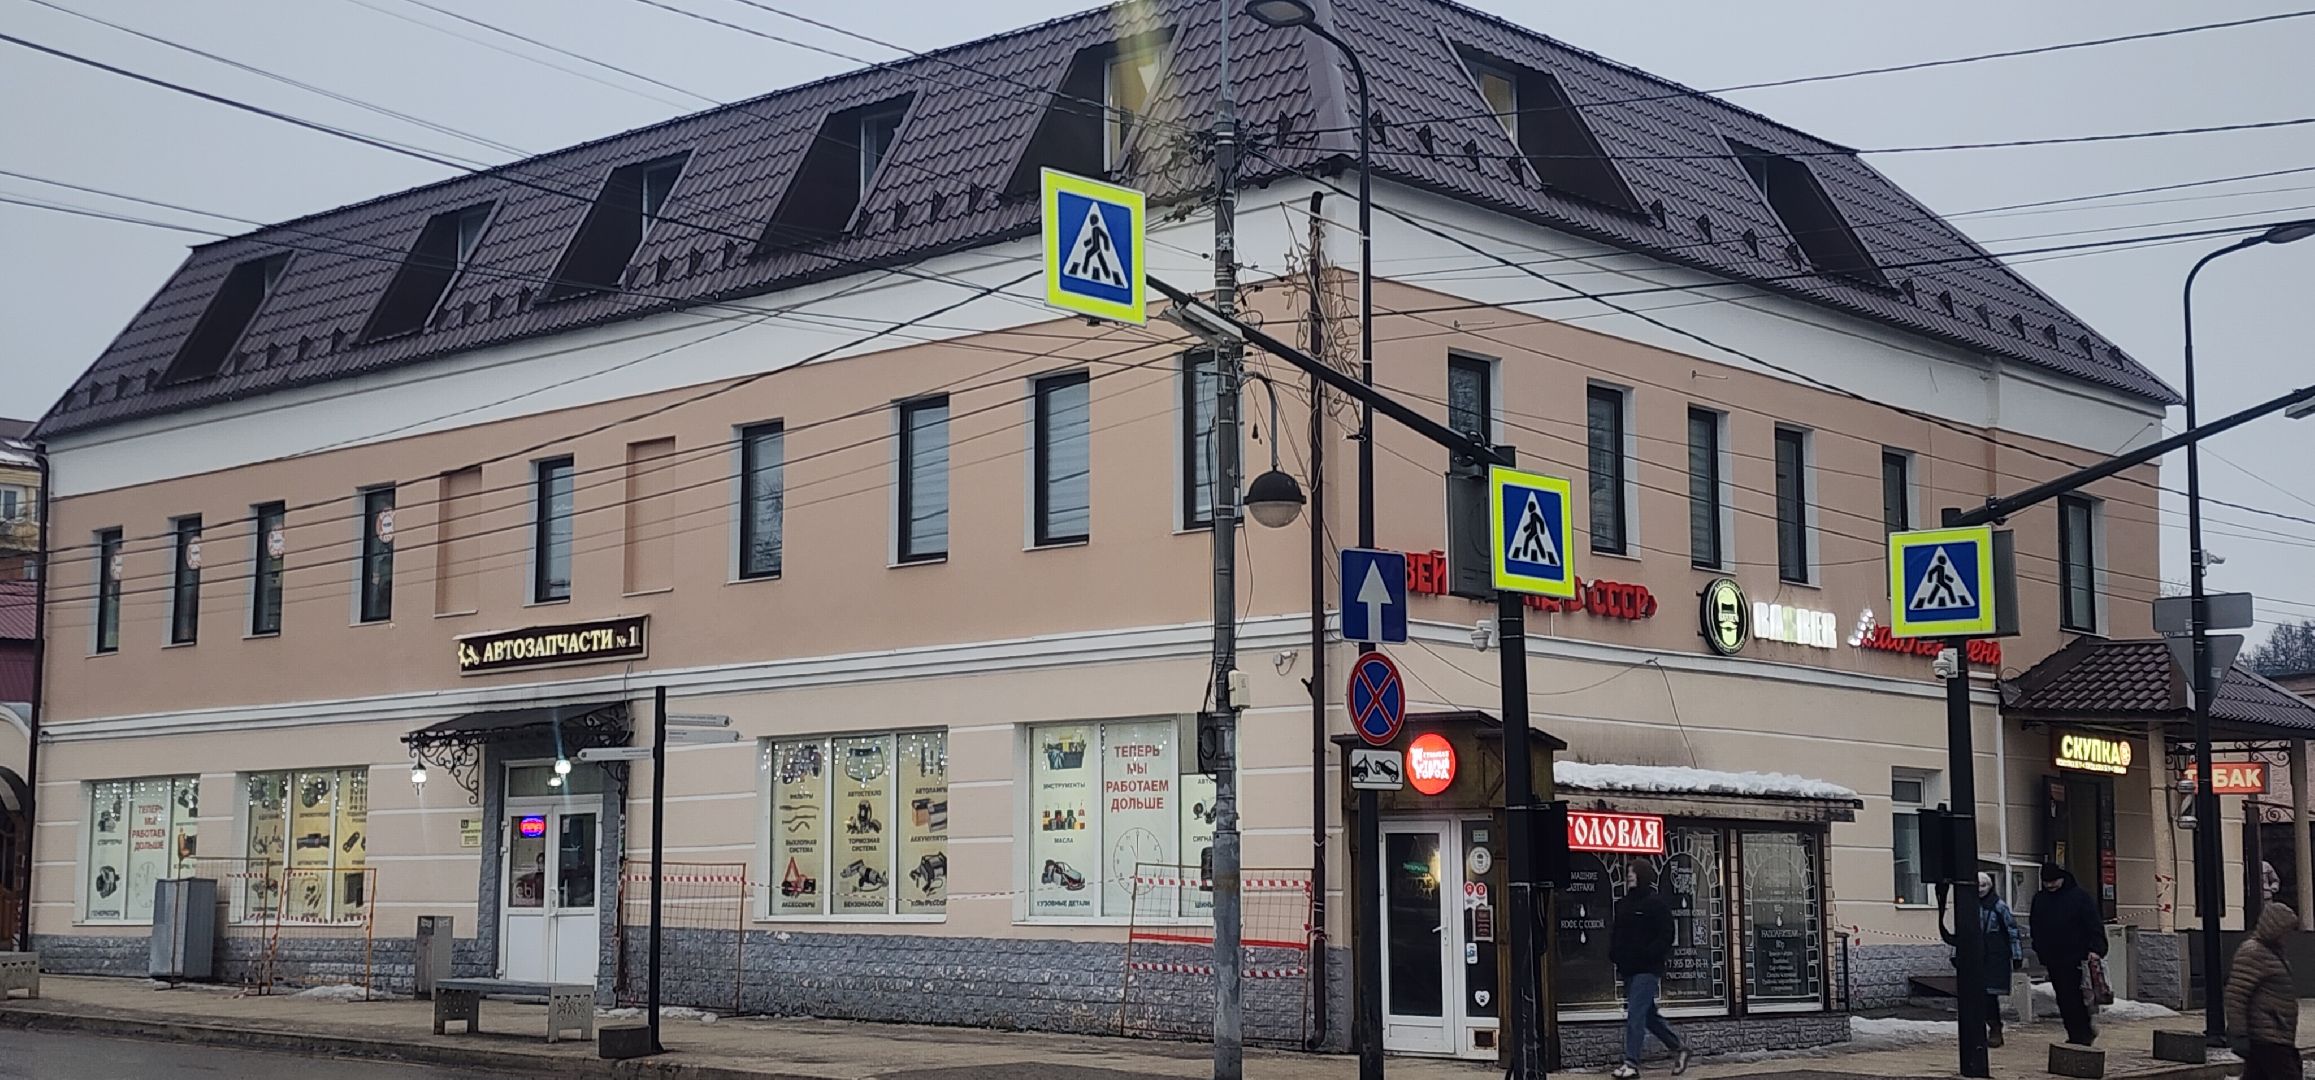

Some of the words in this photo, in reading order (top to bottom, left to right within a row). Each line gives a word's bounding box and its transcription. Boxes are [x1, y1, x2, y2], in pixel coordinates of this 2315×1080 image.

[483, 629, 614, 663] АВТОЗАПЧАСТИ
[629, 626, 640, 647] 1
[1114, 744, 1161, 758] ТЕПЕРЬ
[2061, 735, 2121, 765] СКУПКА
[1127, 762, 1147, 774] МЫ
[2184, 768, 2262, 788] ТБАК
[1043, 782, 1085, 790] ИНСТРУМЕНТЫ
[1106, 780, 1169, 793] РАБОТАЕМ
[139, 804, 163, 814] ТЕПЕРЬ
[1111, 797, 1164, 812] ДОЛЬШЕ
[132, 829, 166, 838] РАБОТАЕМ
[1567, 816, 1660, 849] ОЛОВАЯ
[1192, 835, 1212, 843] СИГНА
[134, 841, 164, 852] ДОЛЬШЕ
[1570, 871, 1599, 880] МАШНИЕ
[1068, 900, 1090, 908] ДЕТАЛИ
